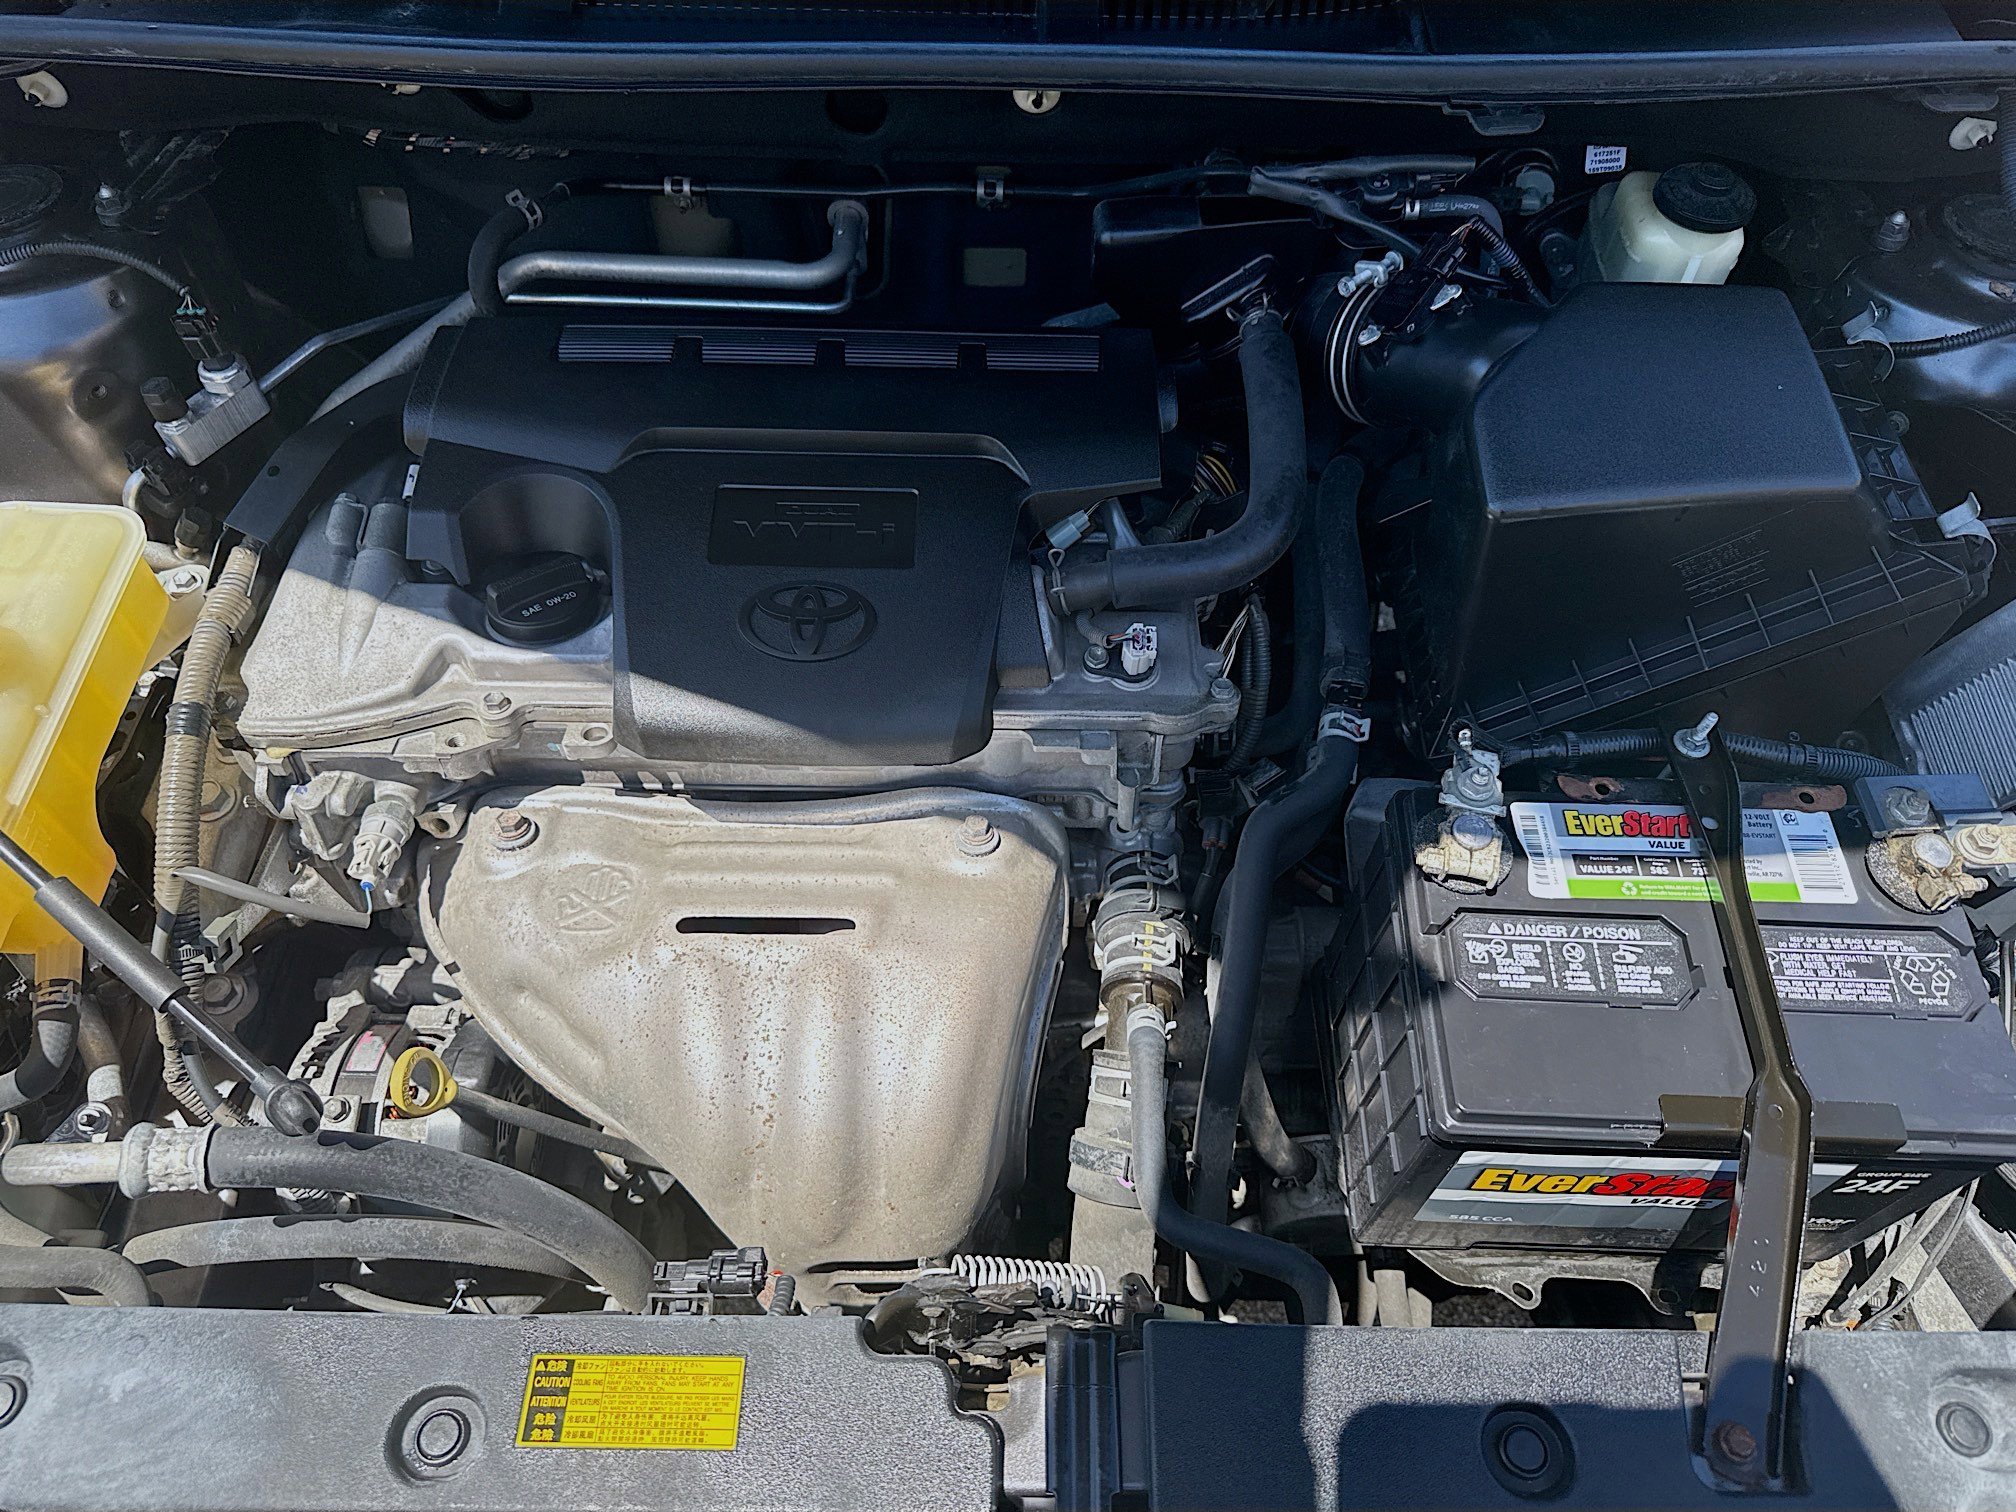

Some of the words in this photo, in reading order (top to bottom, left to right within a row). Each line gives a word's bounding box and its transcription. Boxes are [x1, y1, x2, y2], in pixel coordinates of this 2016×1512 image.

[521, 603, 543, 617] SAE
[546, 591, 577, 607] 0W-20
[1563, 809, 1690, 837] EverStart
[1747, 821, 1773, 829] Battery
[1648, 840, 1686, 850] VALUE
[1580, 864, 1614, 874] VALUE
[1615, 864, 1634, 874] 24F
[1503, 922, 1569, 937] DANGER
[1583, 926, 1641, 941] POISON
[1512, 943, 1542, 952] SHIELD
[1780, 952, 1804, 961] FLUSH
[1804, 953, 1825, 962] EYES
[1825, 954, 1873, 964] IMMEDIATELY
[1781, 960, 1801, 969] WITH
[1831, 961, 1846, 970] GET
[1784, 968, 1817, 977] MEDICAL
[1816, 969, 1837, 977] HELP
[1837, 970, 1857, 978] FAST
[1468, 1166, 1737, 1198] EverStar
[1832, 1179, 1921, 1195] 24F
[1630, 1198, 1714, 1208] VALUE
[1449, 1214, 1480, 1222] 585
[1482, 1215, 1514, 1223] CCA
[534, 1376, 571, 1388] CAUTION
[530, 1395, 568, 1407] ATTENTION
